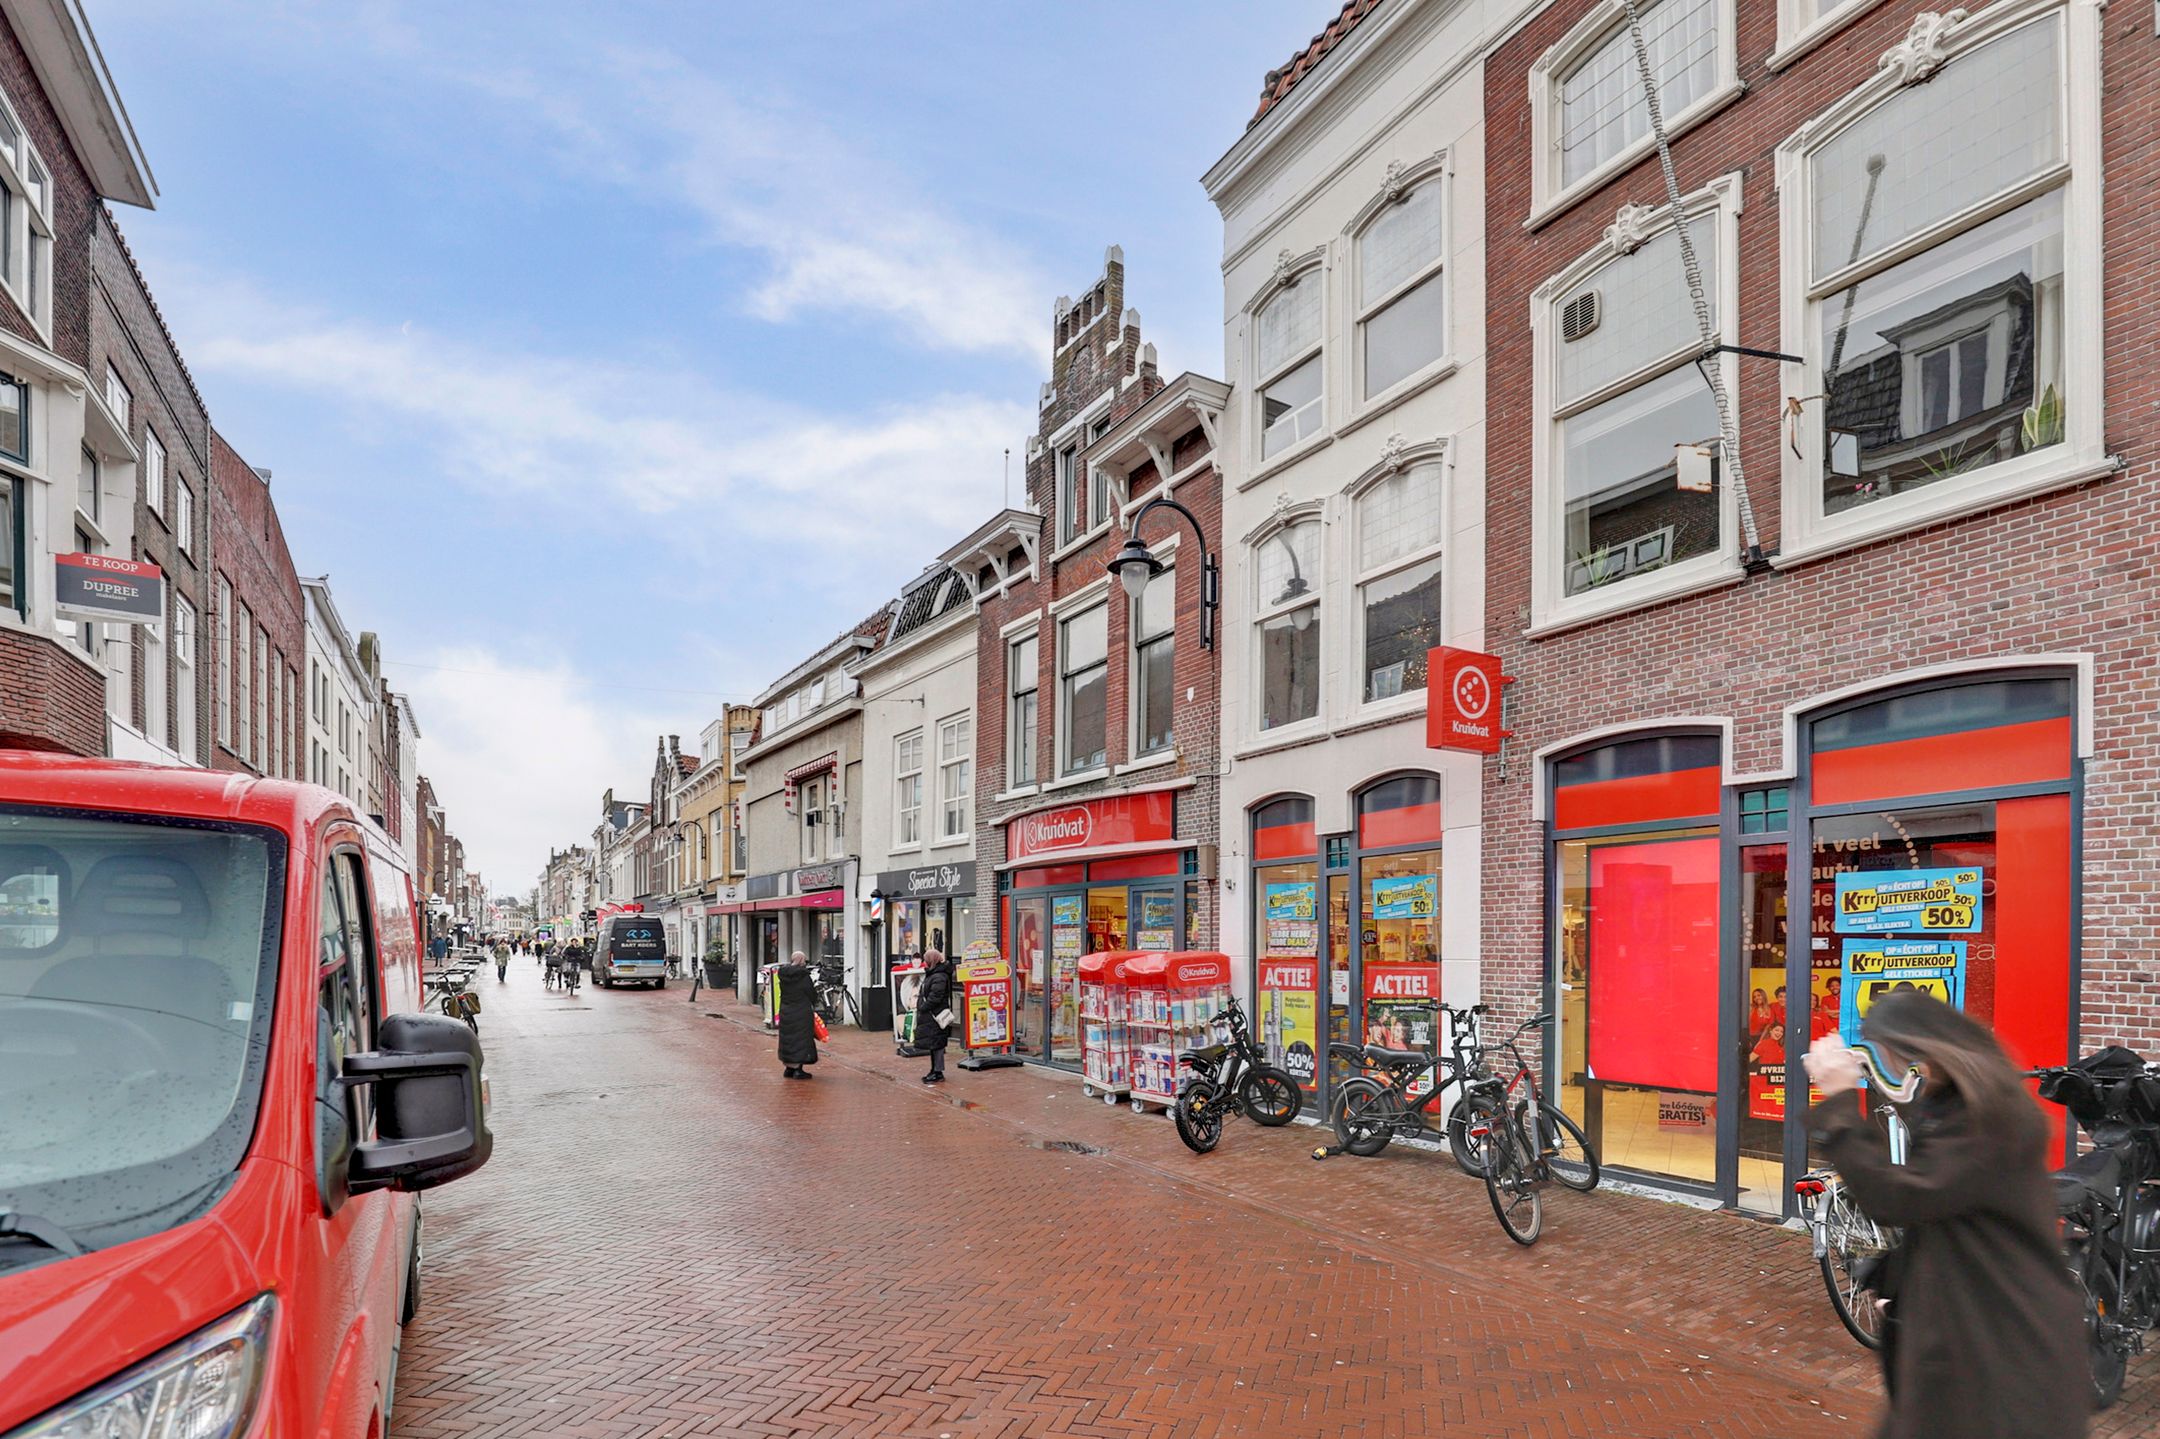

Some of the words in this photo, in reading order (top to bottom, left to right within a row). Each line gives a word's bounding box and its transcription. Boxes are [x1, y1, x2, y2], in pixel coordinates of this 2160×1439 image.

[83, 556, 100, 567] TE
[102, 560, 138, 573] KOOP
[83, 580, 139, 598] DUPREE
[1452, 720, 1490, 737] Kruidvat
[1037, 816, 1085, 842] Kruidvat
[1833, 832, 1881, 852] veel
[908, 868, 938, 896] Special
[939, 866, 961, 892] Style
[1958, 874, 1974, 883] 50%
[1844, 891, 1876, 912] Krrr
[1881, 889, 1951, 905] UITVERKOOP
[1954, 895, 1972, 905] 50%
[1928, 908, 1965, 925] 50%
[1852, 954, 1882, 972] Krrr
[1887, 956, 1952, 968] UITVERKOOP
[1264, 967, 1311, 988] ACTIE!
[1373, 974, 1428, 996] ACTIE!
[971, 982, 1006, 995] ACTIE!
[1287, 1052, 1315, 1070] 50%
[1760, 1066, 1785, 1074] #VRIE
[1658, 1109, 1706, 1125] GRATIS!
